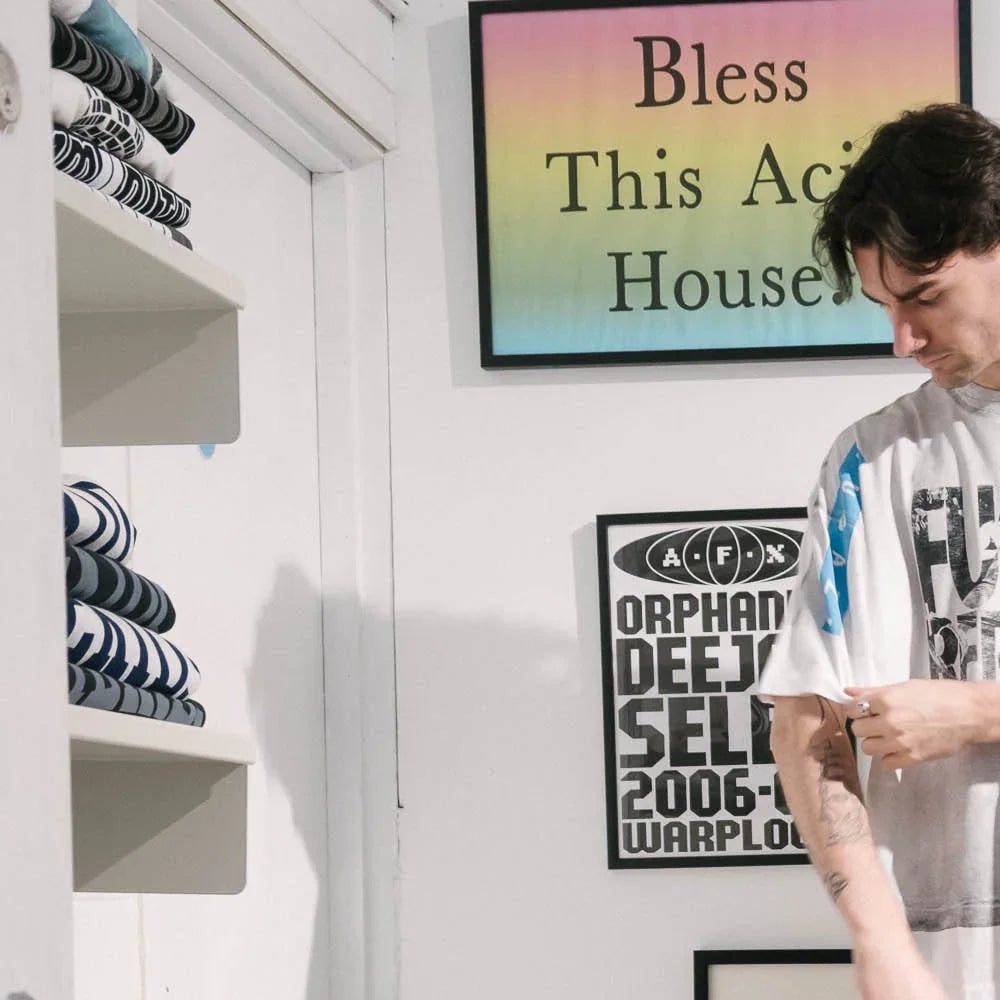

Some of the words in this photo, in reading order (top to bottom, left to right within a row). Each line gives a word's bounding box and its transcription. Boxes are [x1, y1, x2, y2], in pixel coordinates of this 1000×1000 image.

[633, 36, 808, 108] Bless
[545, 148, 702, 213] This
[741, 141, 853, 206] Aci
[607, 250, 844, 312] House.
[616, 589, 793, 635] ORPHAN
